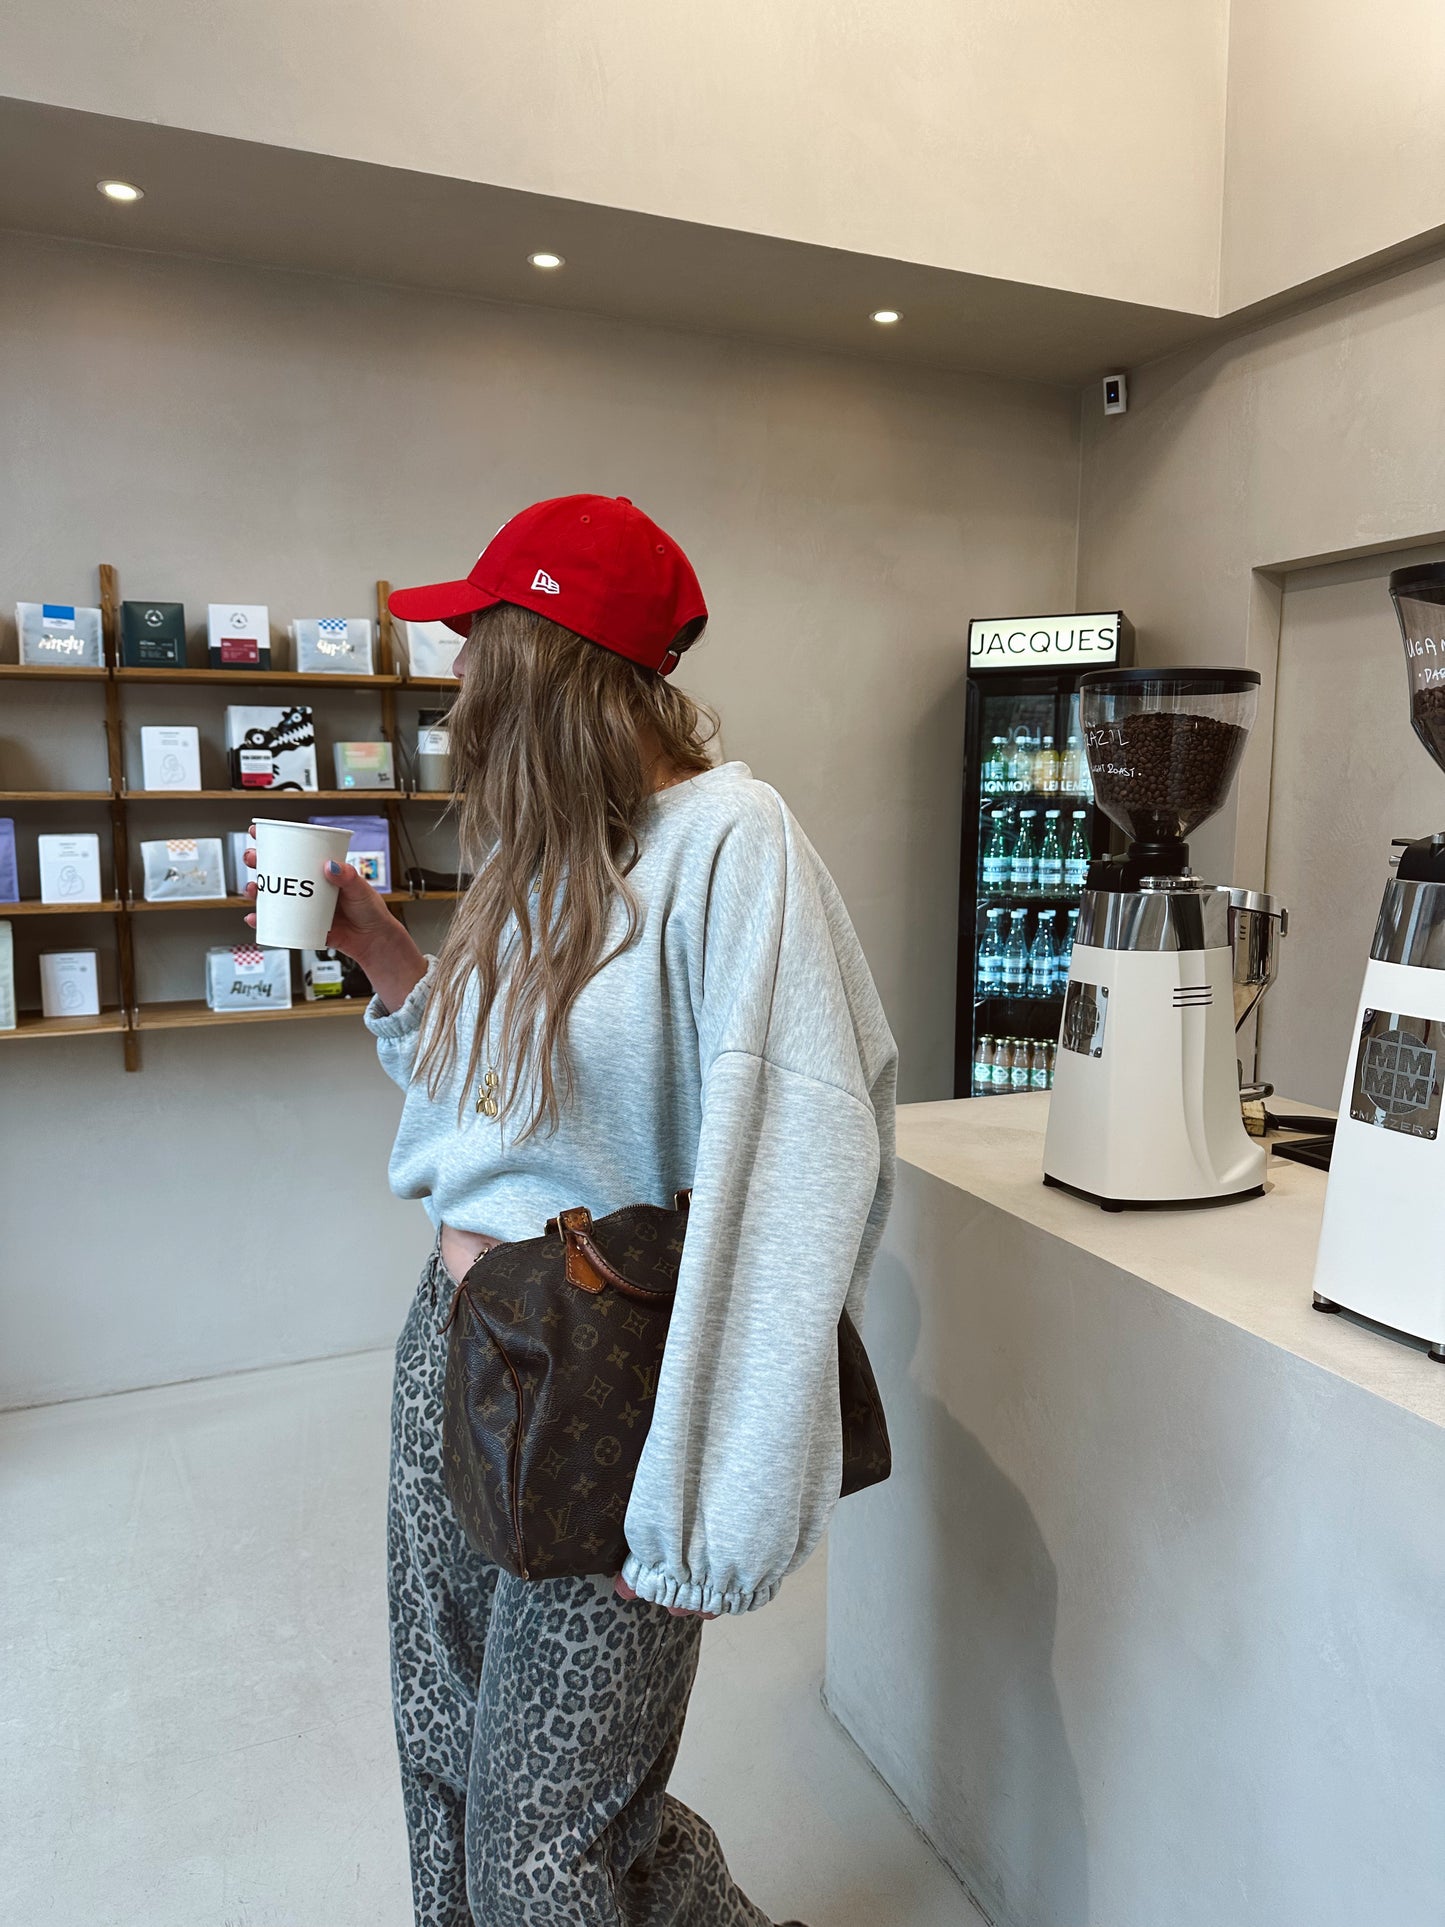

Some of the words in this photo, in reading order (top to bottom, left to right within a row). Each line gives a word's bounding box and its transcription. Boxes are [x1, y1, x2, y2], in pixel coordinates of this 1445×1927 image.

[971, 628, 1115, 656] JACQUES
[257, 873, 315, 898] QUES
[230, 978, 273, 998] Andy
